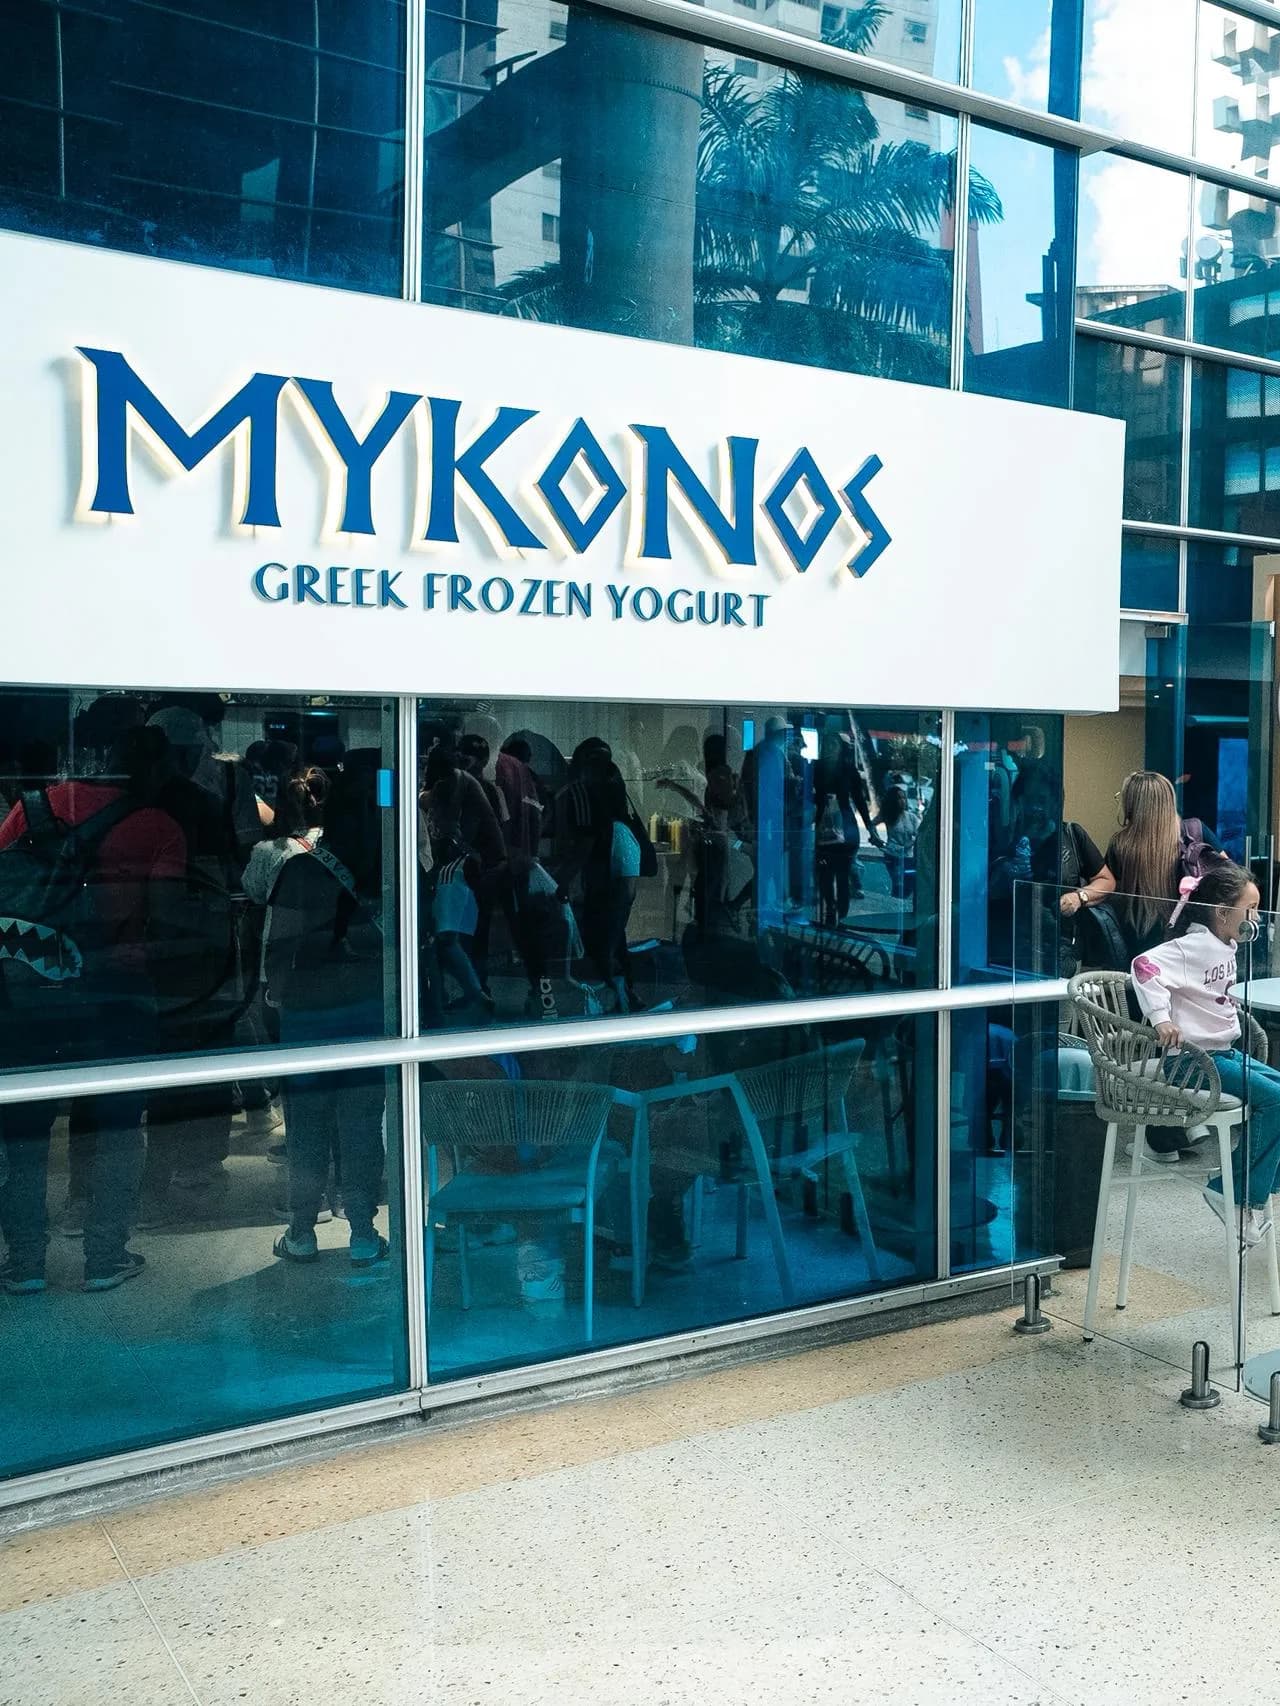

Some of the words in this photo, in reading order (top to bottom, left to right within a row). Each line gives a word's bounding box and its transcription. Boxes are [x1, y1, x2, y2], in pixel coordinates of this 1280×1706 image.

[75, 346, 892, 578] MYKONOS
[252, 562, 408, 608] GREEK
[424, 572, 592, 618] FROZEN
[604, 584, 771, 627] YOGURT
[1203, 964, 1225, 985] LOS
